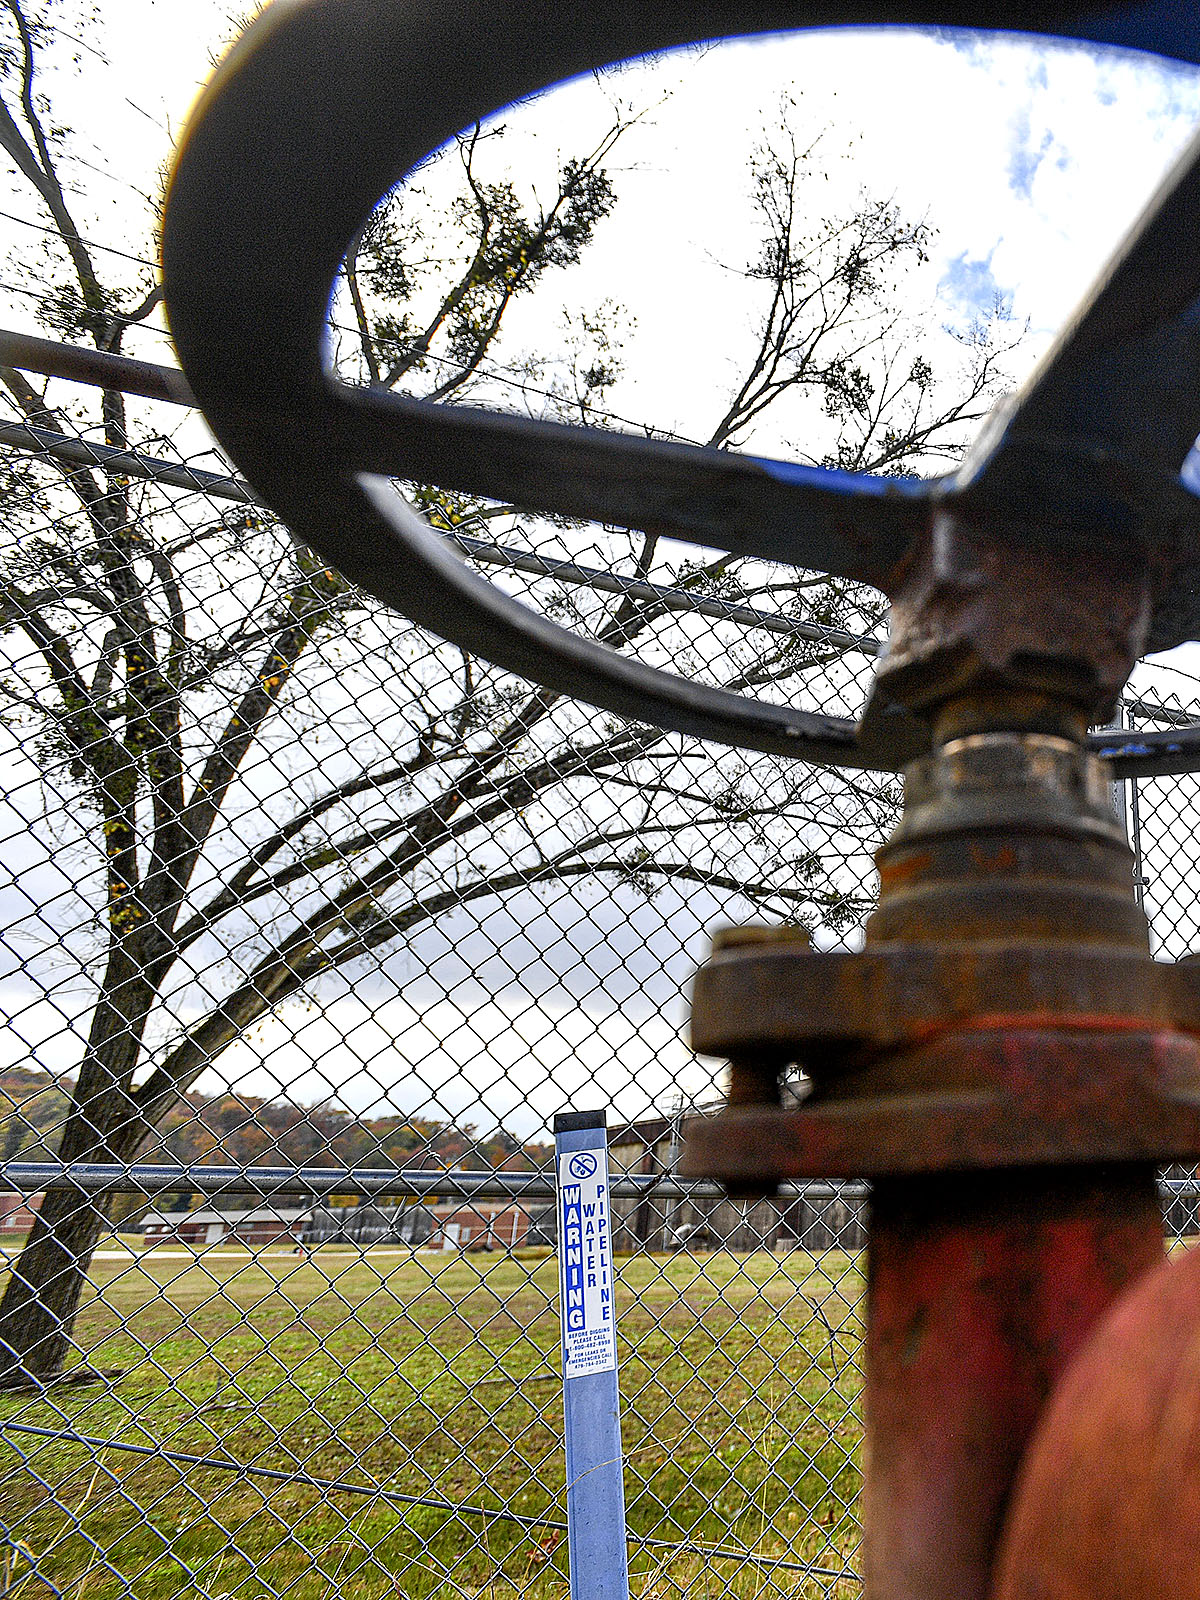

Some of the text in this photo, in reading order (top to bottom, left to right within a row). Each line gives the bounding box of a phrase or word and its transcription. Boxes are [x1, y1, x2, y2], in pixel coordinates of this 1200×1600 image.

[563, 1186, 584, 1329] WARNING
[583, 1203, 597, 1288] WATER
[597, 1184, 610, 1321] PIPELINE
[569, 1327, 610, 1339] BEFORE DIGGING
[573, 1336, 591, 1344] PLEASE
